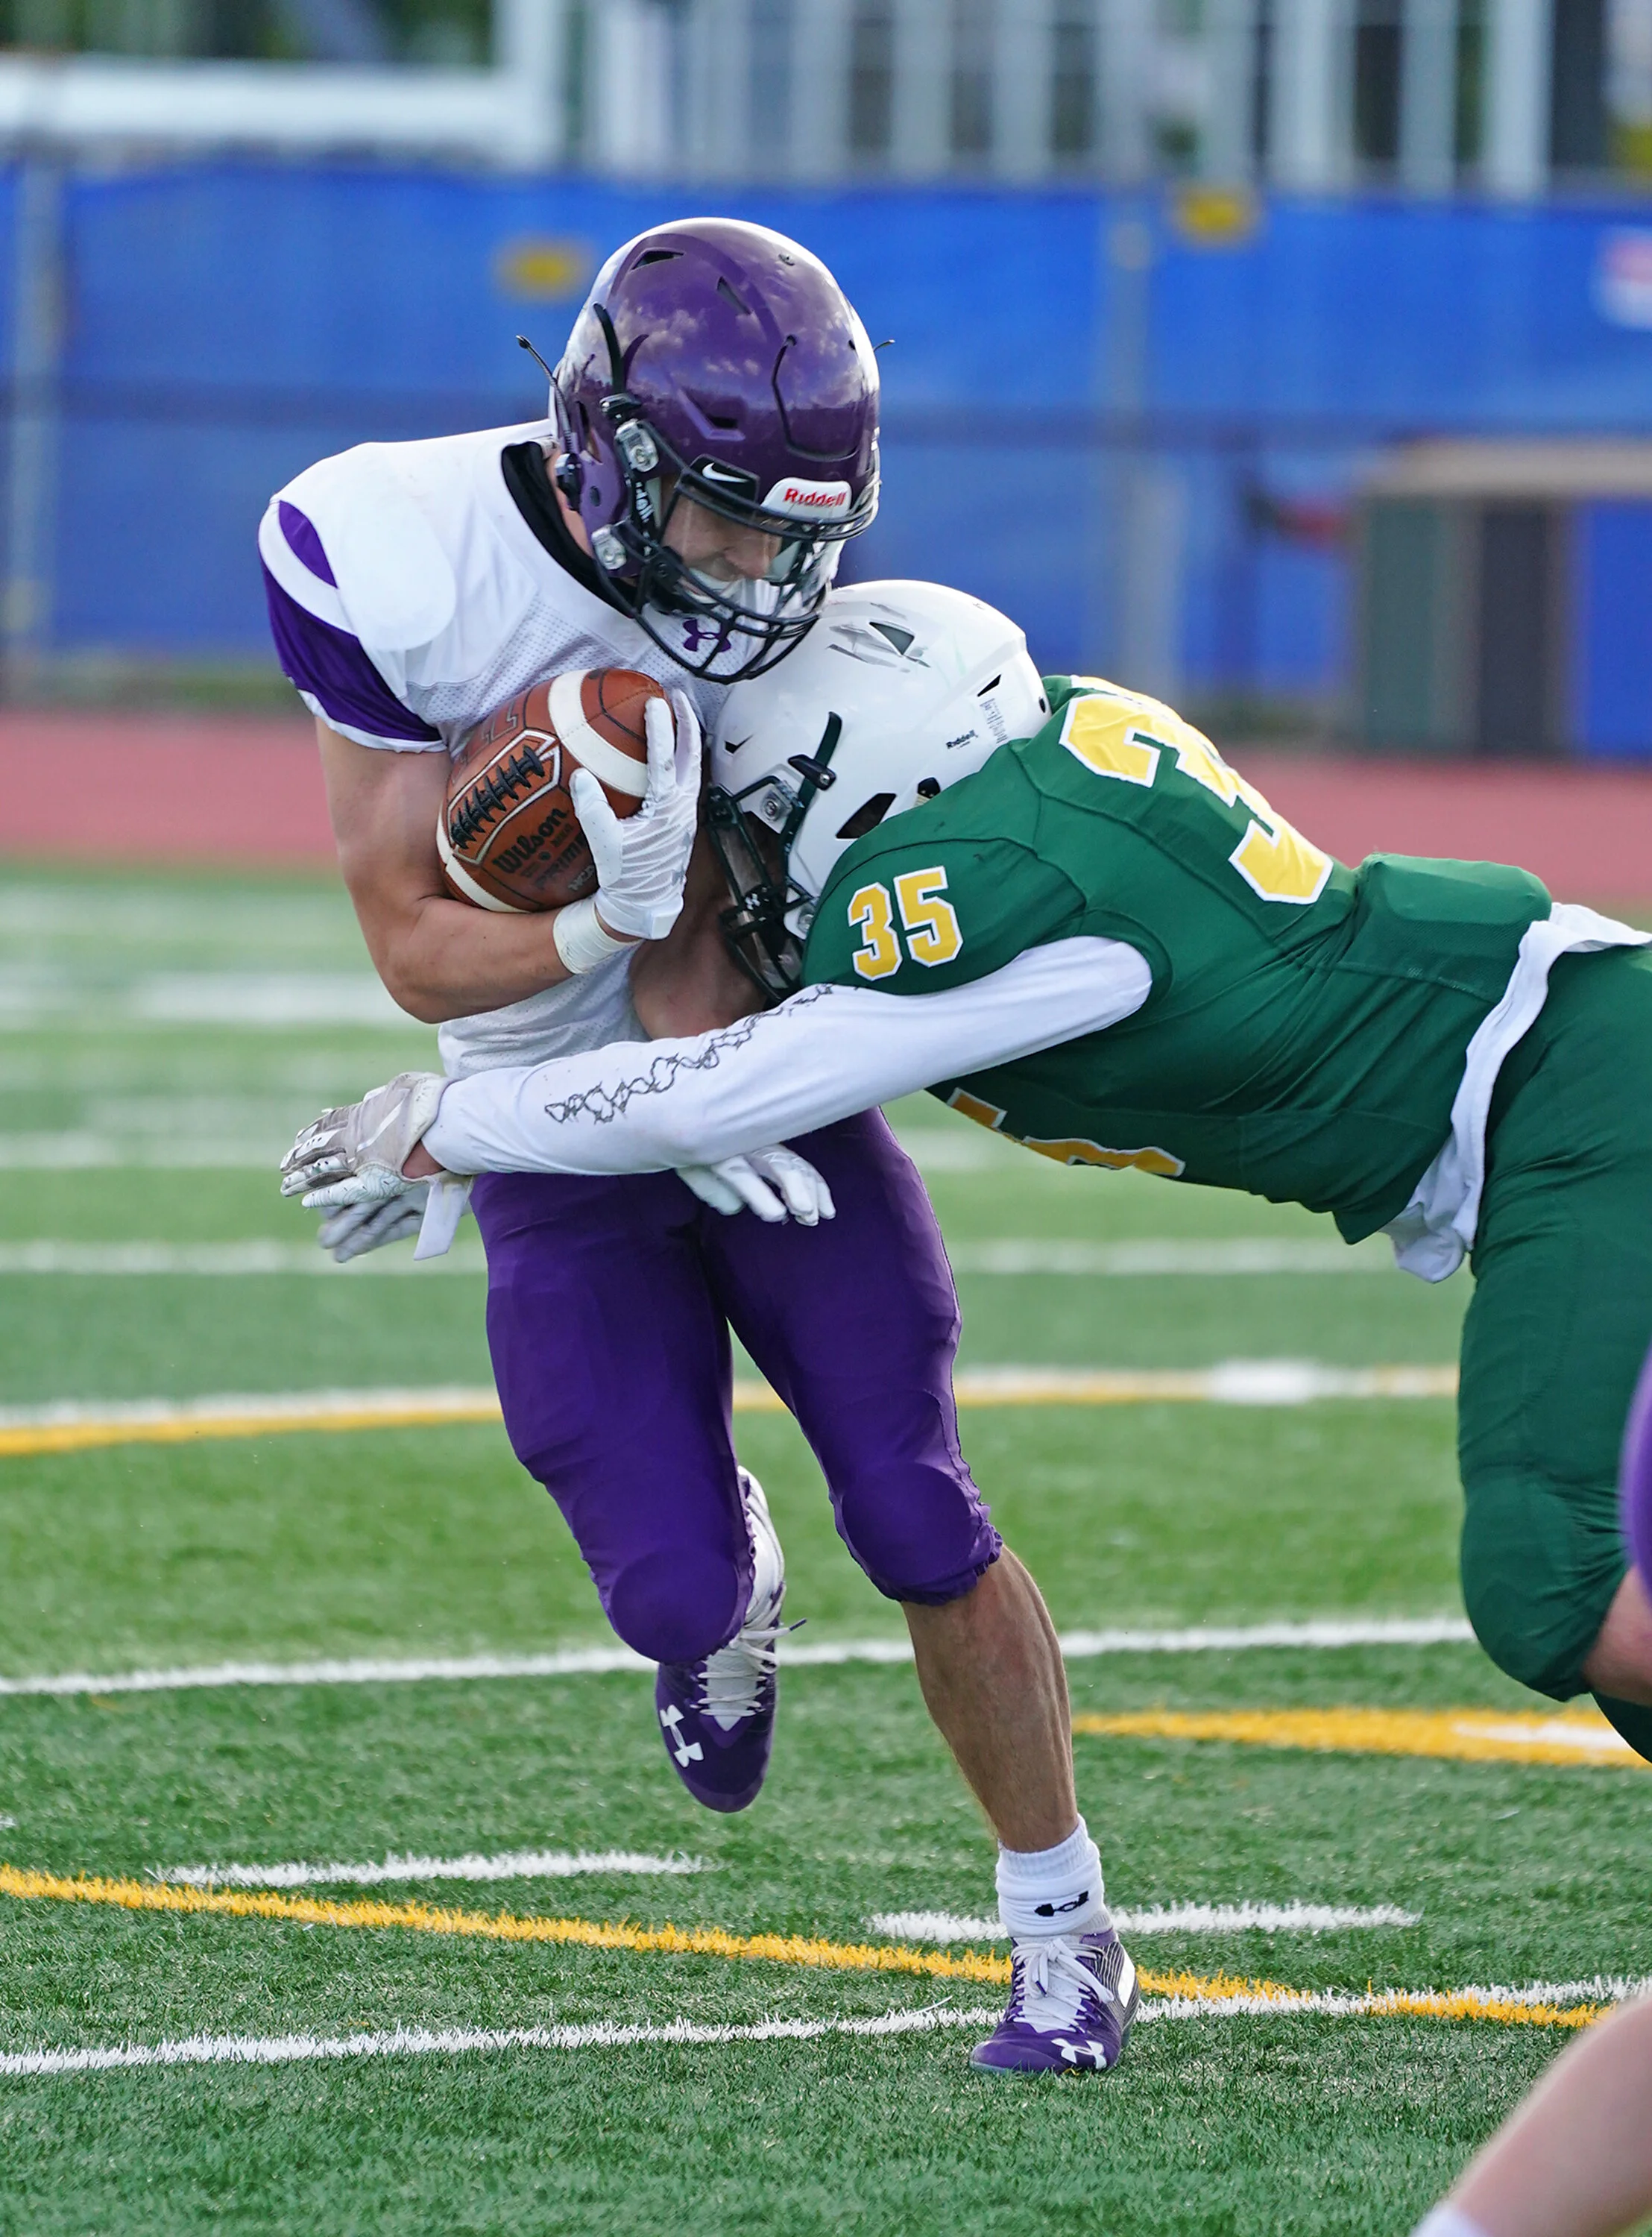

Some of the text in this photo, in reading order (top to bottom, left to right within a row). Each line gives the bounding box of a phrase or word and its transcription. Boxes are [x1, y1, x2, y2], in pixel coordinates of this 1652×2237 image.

[784, 488, 846, 507] Riddell
[492, 808, 570, 873] Wilson
[847, 865, 964, 981] 35
